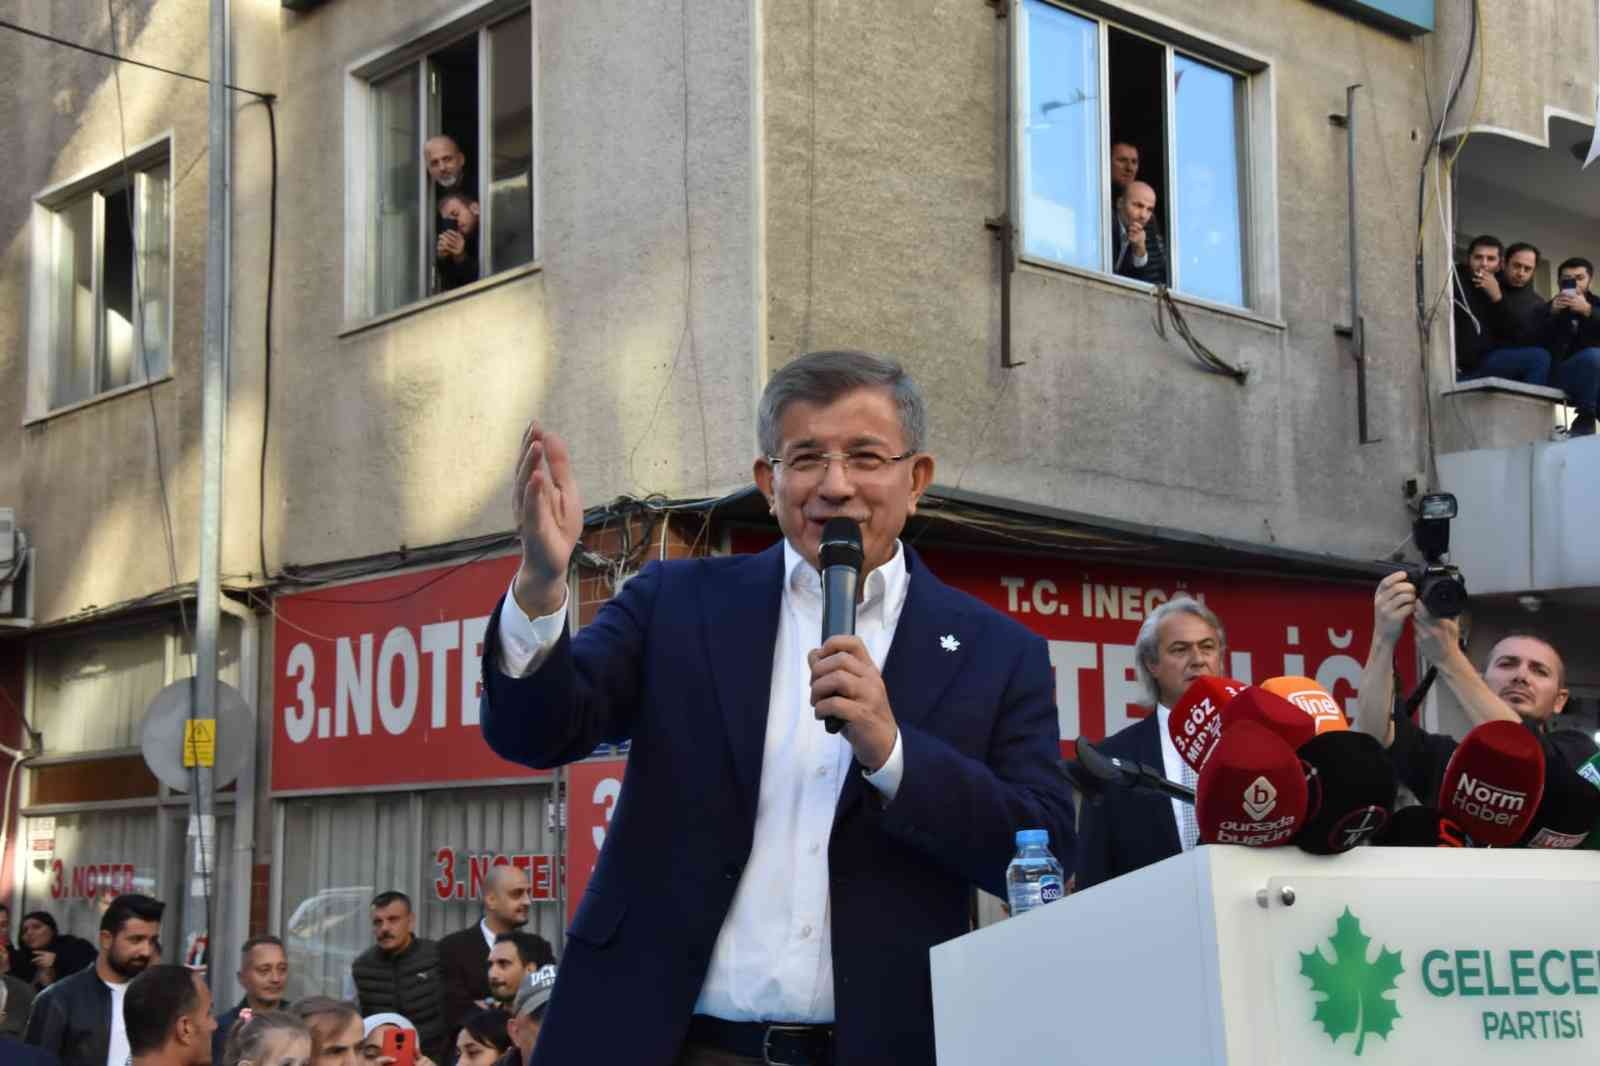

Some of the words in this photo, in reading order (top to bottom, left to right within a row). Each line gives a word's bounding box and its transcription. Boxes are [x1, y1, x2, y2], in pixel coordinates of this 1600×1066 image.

[1001, 577, 1069, 616] T.C.
[1184, 698, 1216, 734] GÖZ
[1452, 791, 1520, 826] Haber
[1457, 772, 1527, 810] Norm
[1421, 948, 1600, 998] GELECE
